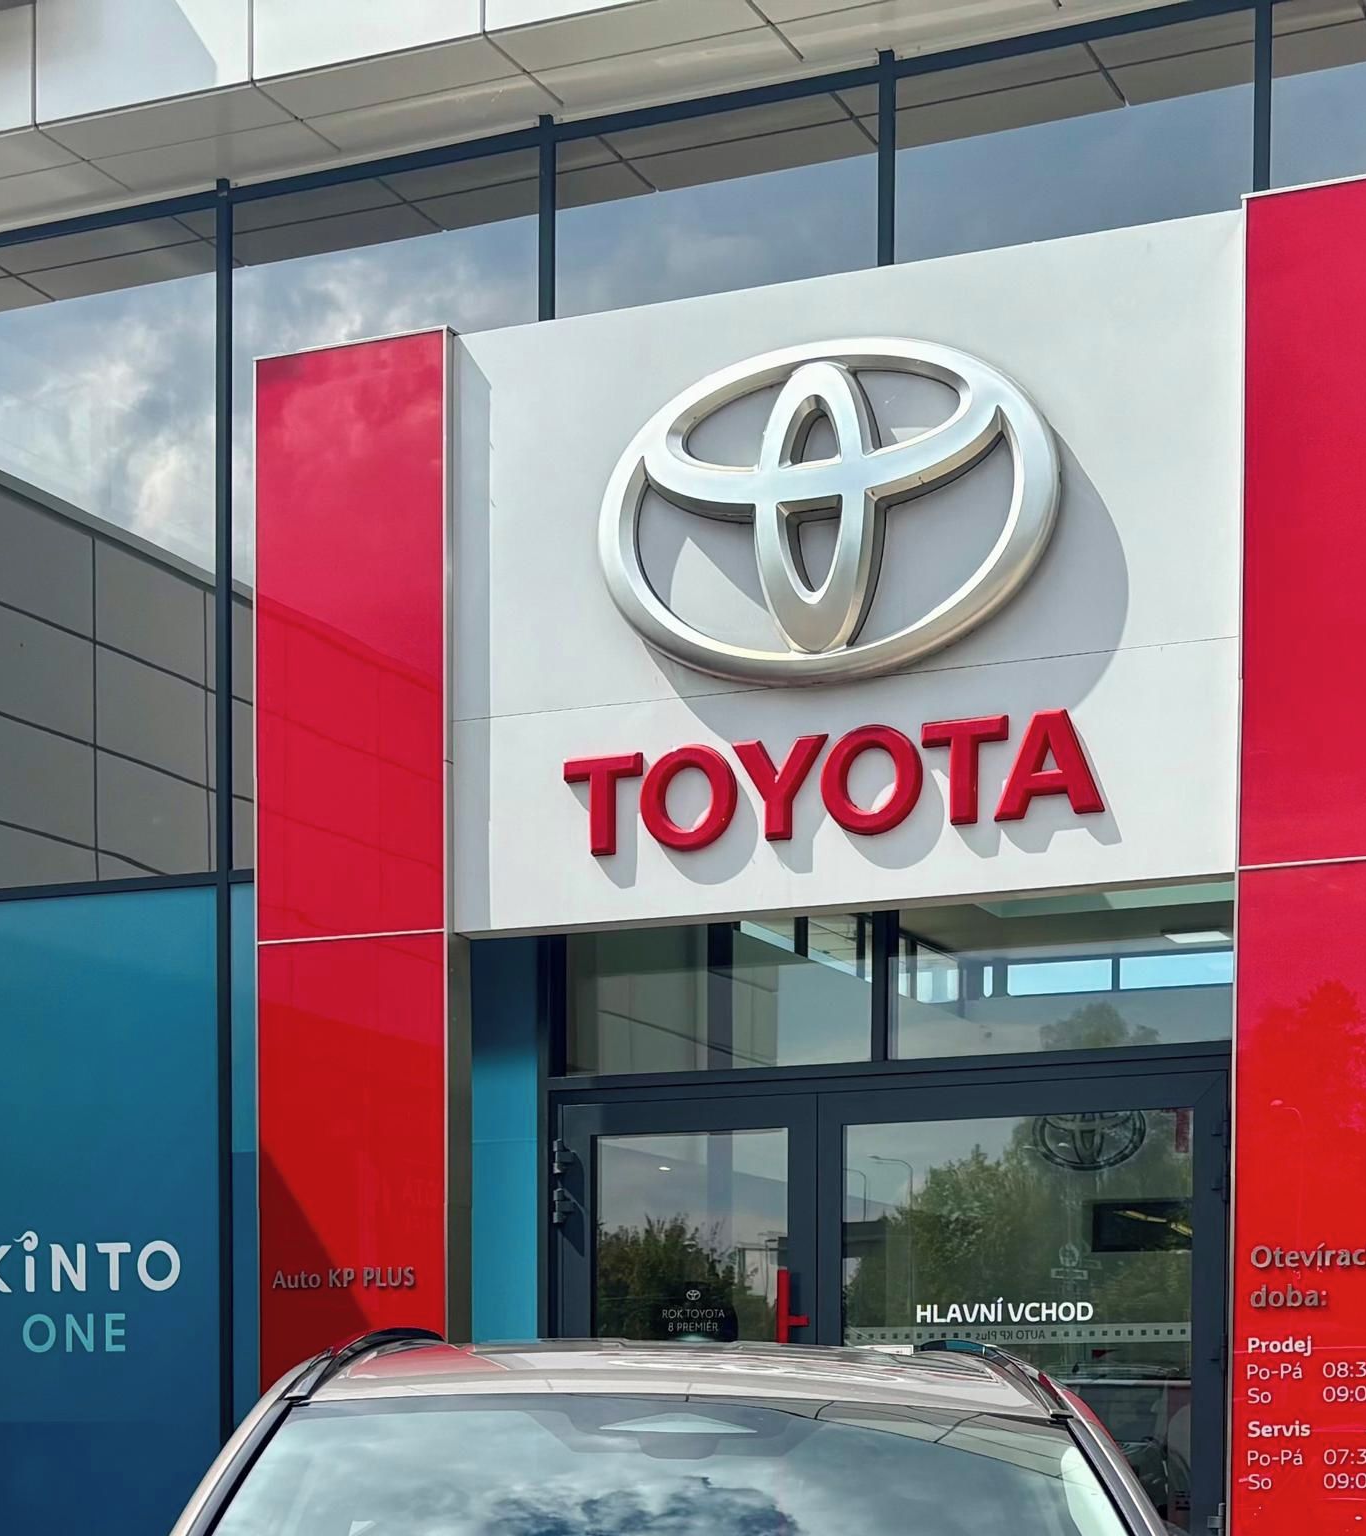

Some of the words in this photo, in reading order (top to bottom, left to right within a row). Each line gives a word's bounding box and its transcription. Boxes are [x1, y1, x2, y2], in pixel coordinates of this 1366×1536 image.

[563, 708, 1105, 857] TOYOTA
[272, 1270, 321, 1289] Auto
[328, 1268, 355, 1288] KP
[363, 1266, 415, 1287] PLUS
[1250, 1284, 1328, 1308] doba:
[662, 1309, 683, 1319] ROK
[686, 1308, 726, 1319] TOYOTA
[916, 1297, 1004, 1323] HLAVNÍ
[1008, 1301, 1094, 1322] VCHOD
[22, 1313, 125, 1353] ONE
[667, 1322, 674, 1332] 8
[676, 1319, 719, 1332] PREMIÉR
[1247, 1336, 1312, 1356] Prodej
[1246, 1362, 1303, 1380] Po-Pá
[1247, 1387, 1272, 1404] So
[1247, 1420, 1311, 1438] Servis
[1247, 1449, 1303, 1466] Po-Pá
[1248, 1473, 1272, 1490] So
